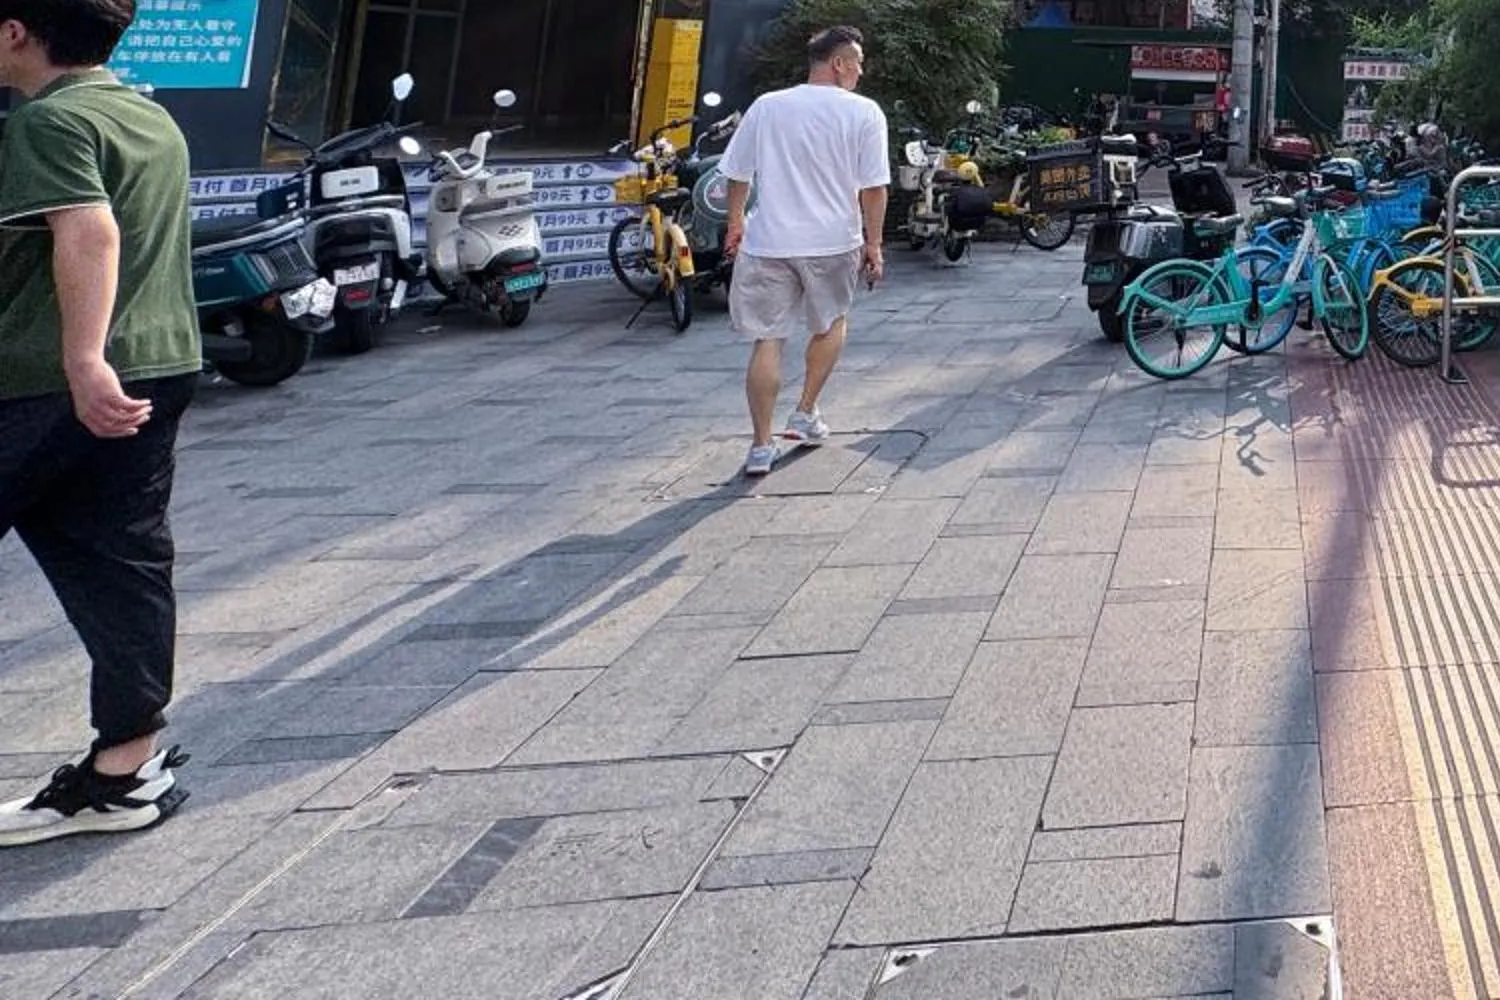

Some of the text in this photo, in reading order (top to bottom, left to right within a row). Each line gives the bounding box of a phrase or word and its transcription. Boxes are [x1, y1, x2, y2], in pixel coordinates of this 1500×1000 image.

[129, 18, 237, 32] 处为无人看守
[109, 50, 231, 63] 车停放在有人看
